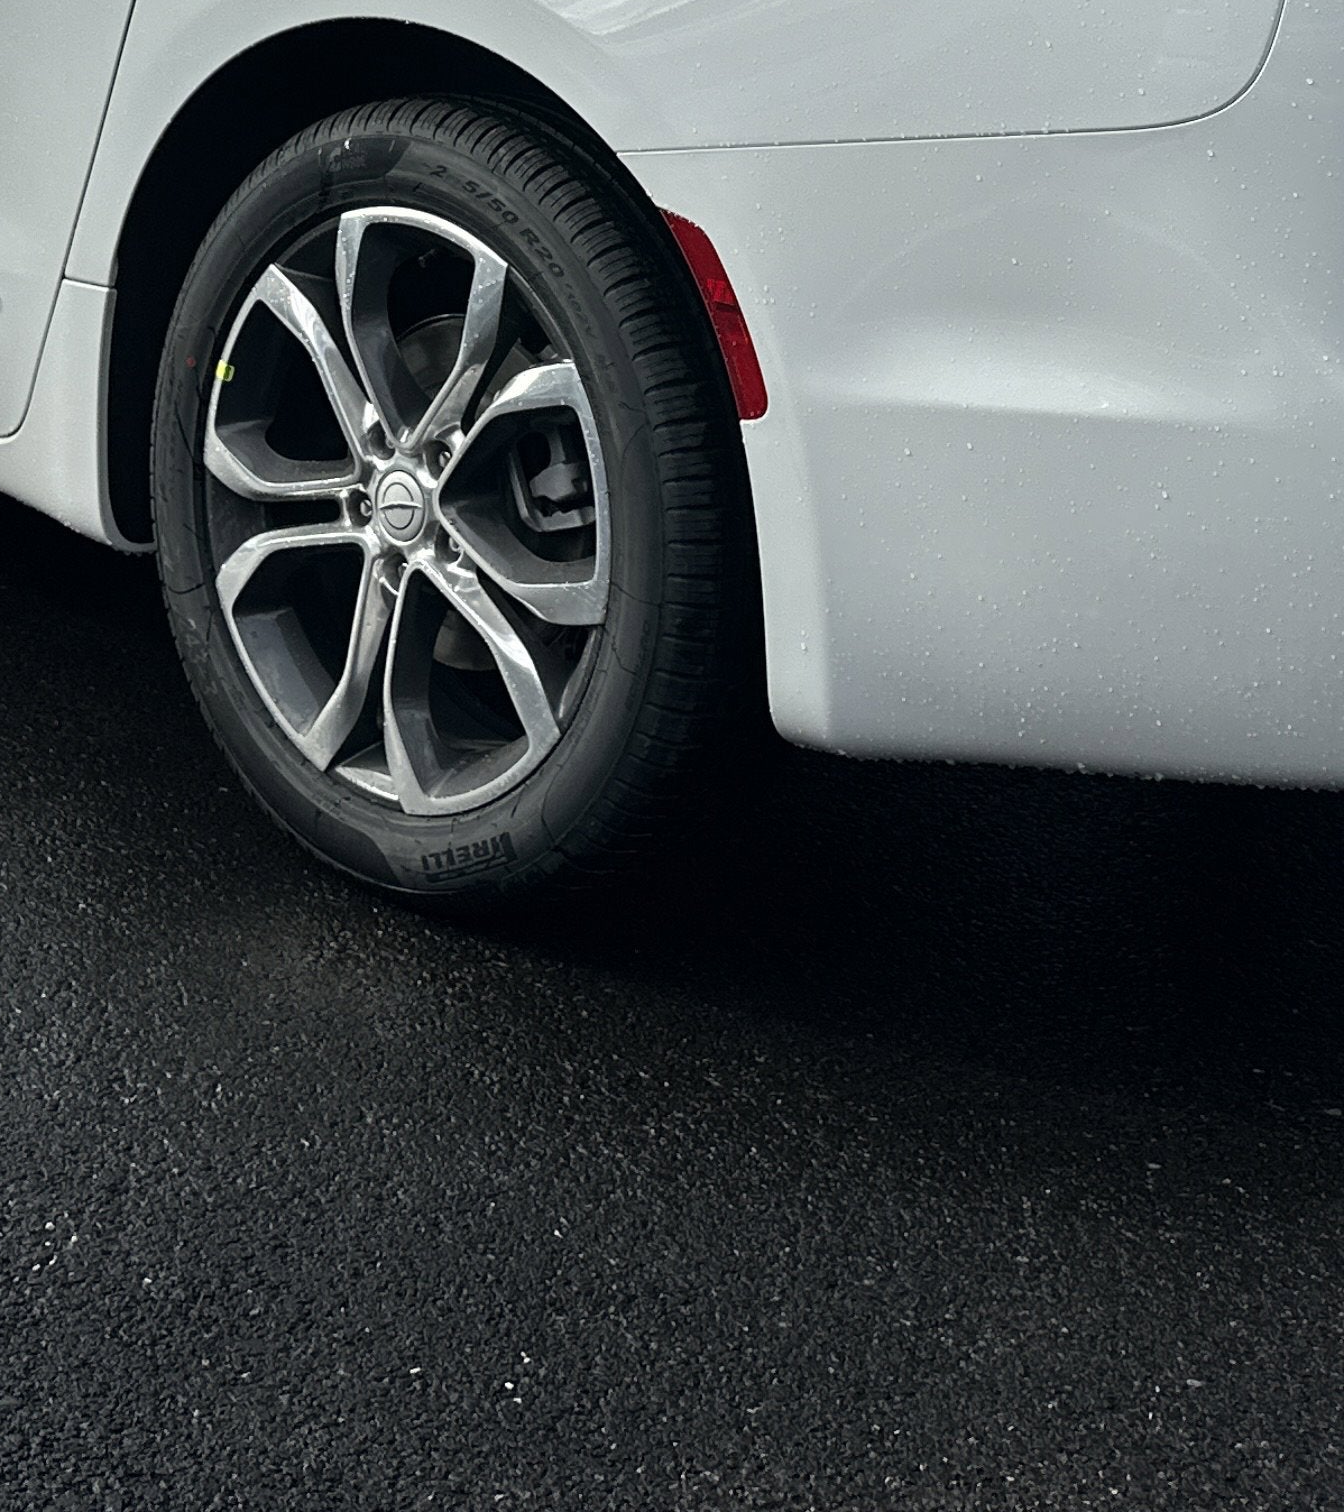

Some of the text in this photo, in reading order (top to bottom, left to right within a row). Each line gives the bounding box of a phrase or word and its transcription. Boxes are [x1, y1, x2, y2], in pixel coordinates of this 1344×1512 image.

[429, 163, 520, 226] 25/50
[519, 227, 566, 279] R20
[418, 831, 519, 883] PIRELLI
